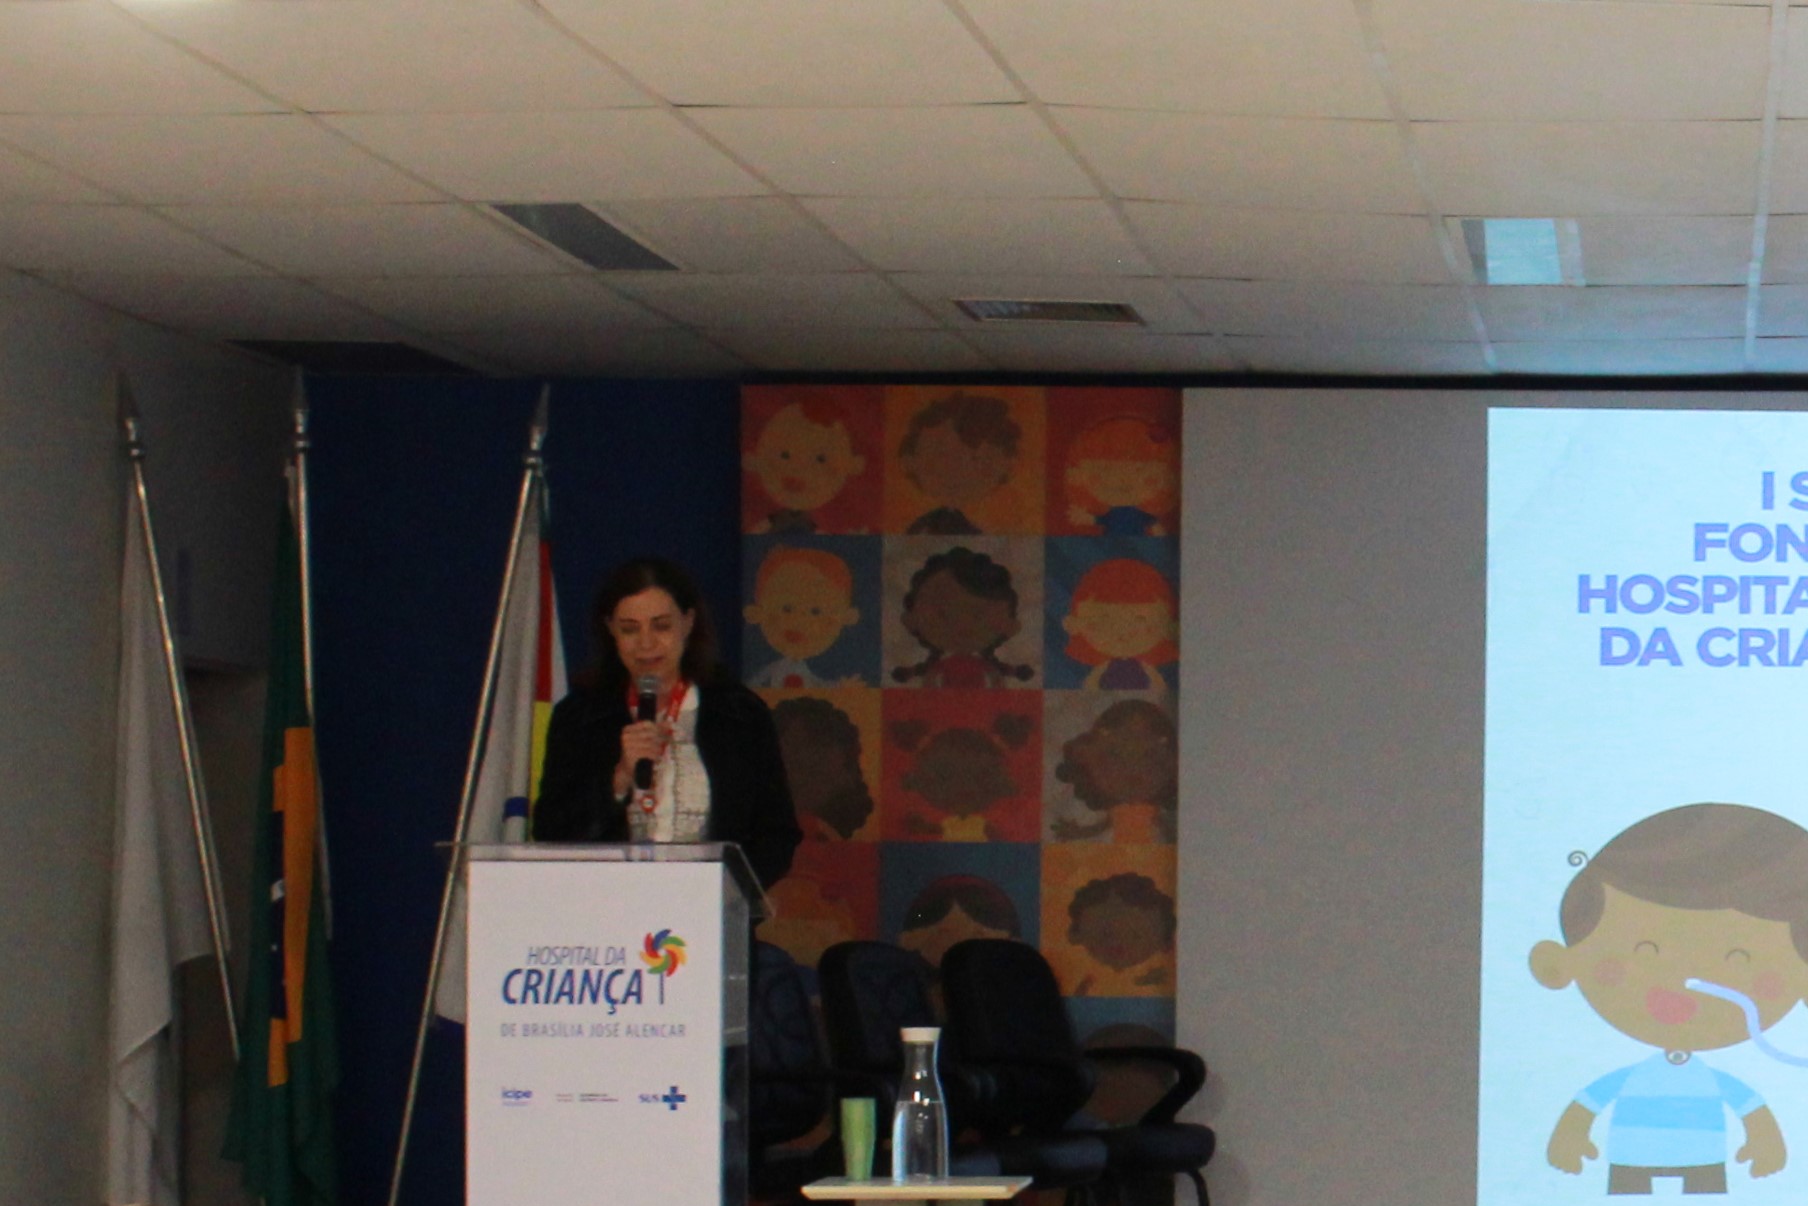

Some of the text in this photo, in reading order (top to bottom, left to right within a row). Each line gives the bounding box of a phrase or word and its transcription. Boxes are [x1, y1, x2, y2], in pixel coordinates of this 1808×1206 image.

[1761, 471, 1776, 511] I
[1599, 626, 1684, 668] DA
[526, 946, 627, 967] HOSPITAL DA
[501, 968, 643, 1016] CRIANÇA
[500, 1021, 686, 1038] DE BRASÍLIA JOSÉ ALENCAR
